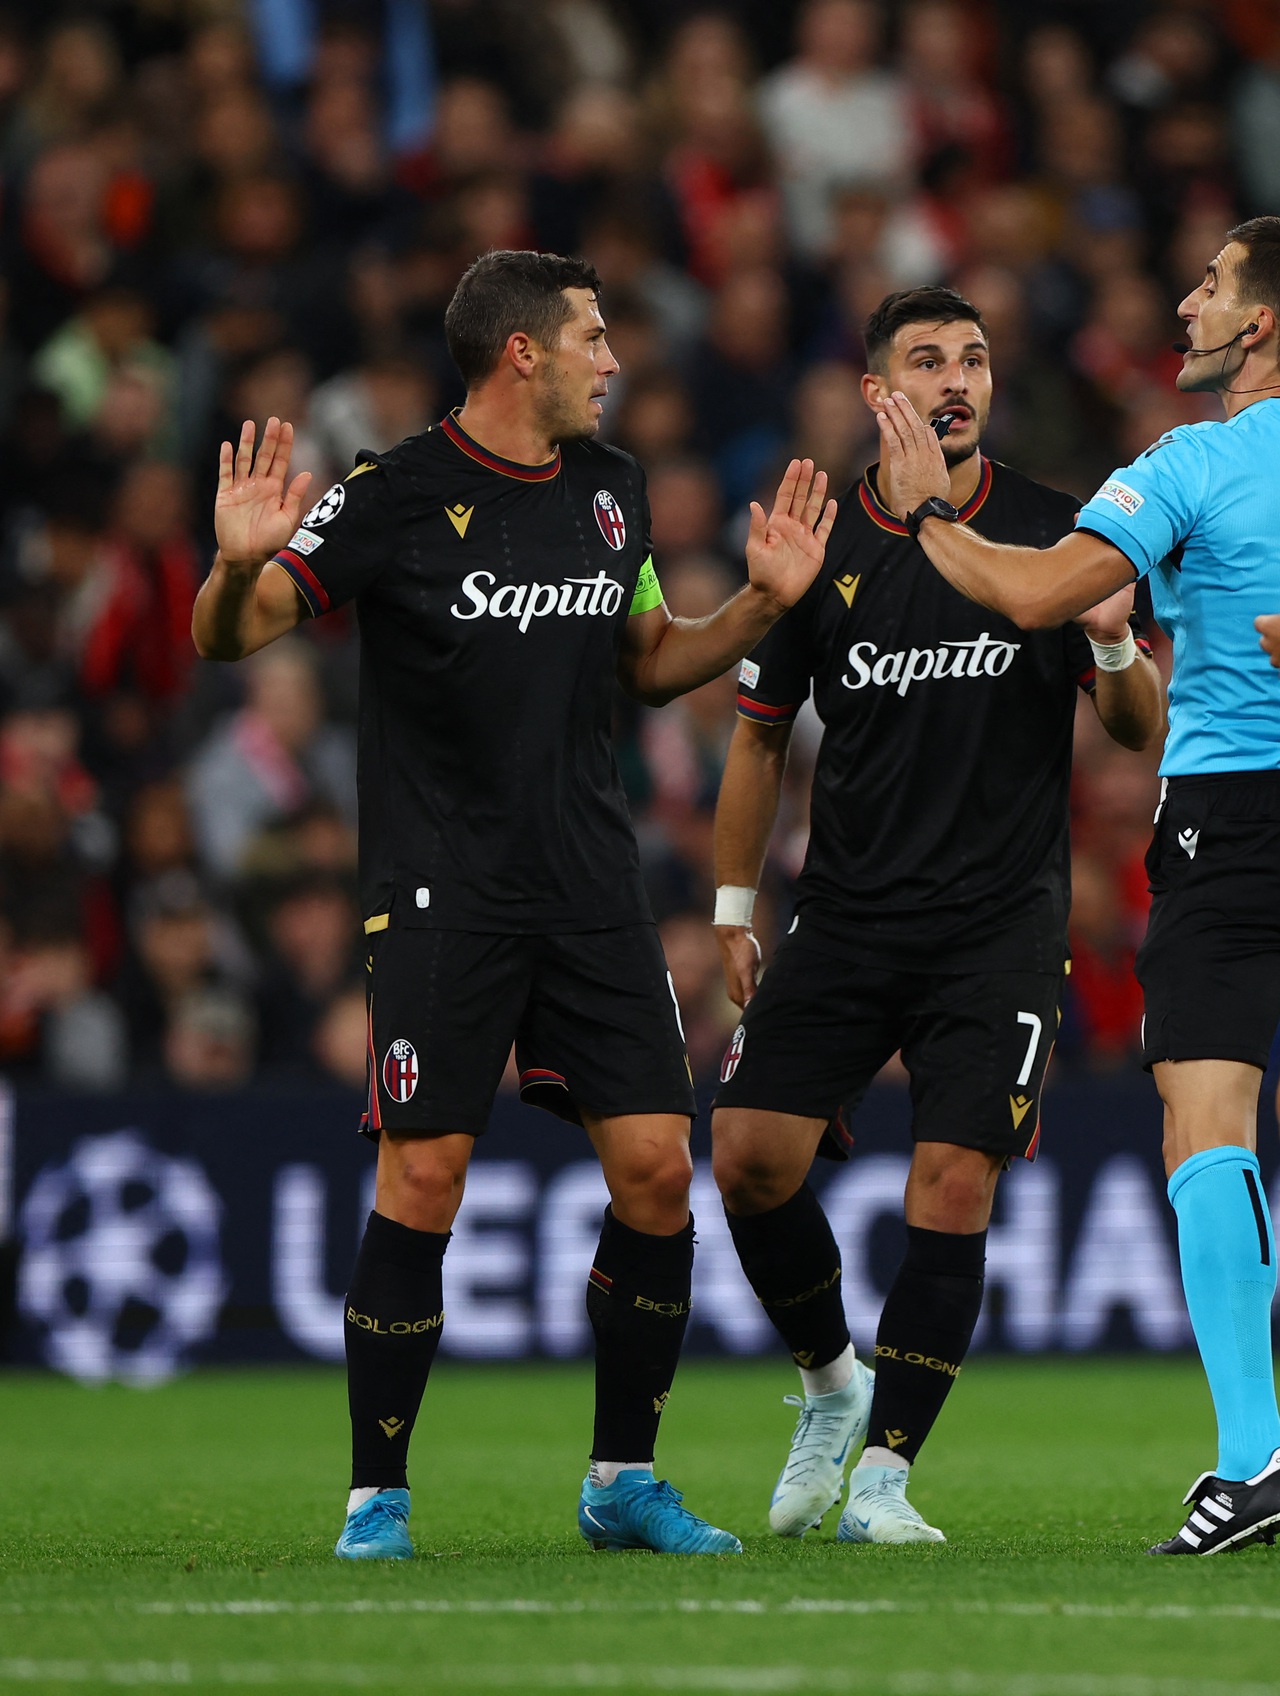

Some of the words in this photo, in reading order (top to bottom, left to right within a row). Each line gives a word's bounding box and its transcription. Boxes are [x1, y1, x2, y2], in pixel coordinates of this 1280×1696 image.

[450, 570, 625, 634] Saputo
[841, 632, 1022, 697] Saputo
[393, 1041, 410, 1055] BFC
[1016, 1011, 1042, 1086] 7
[347, 1306, 446, 1335] BOLOGNA
[874, 1344, 962, 1378] BOLOGNA
